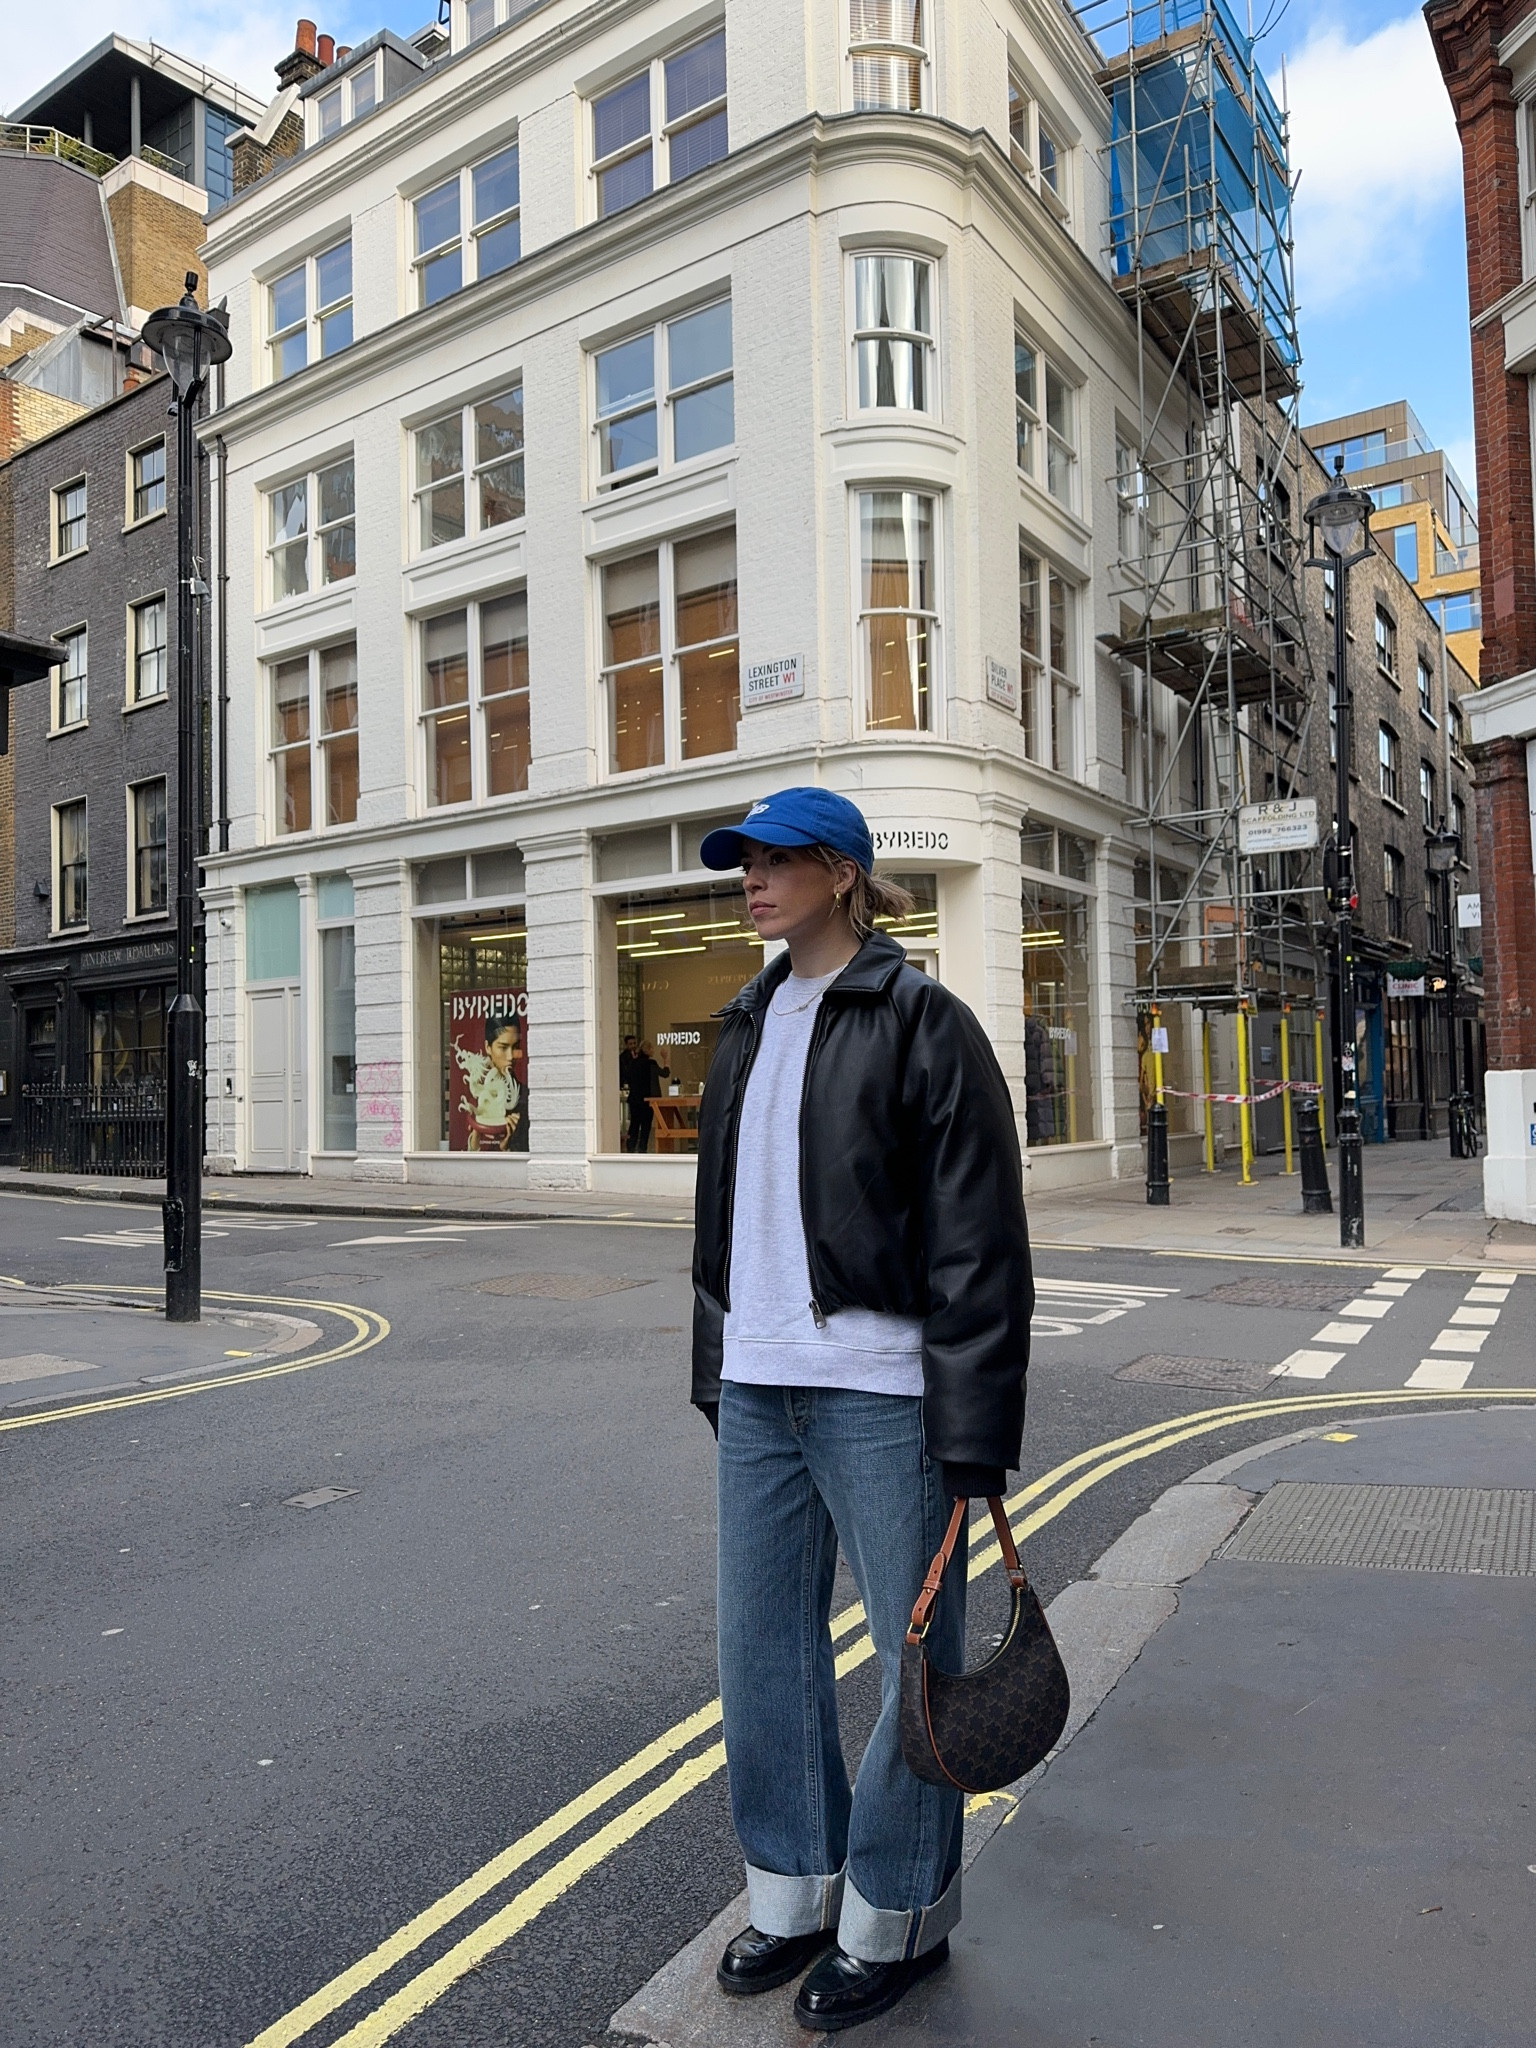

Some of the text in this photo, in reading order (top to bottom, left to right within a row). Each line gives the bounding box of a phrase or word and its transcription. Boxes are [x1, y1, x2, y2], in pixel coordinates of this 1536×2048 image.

[748, 657, 797, 679] LEXINGTON
[991, 661, 1008, 679] SILVER
[748, 671, 796, 692] STREET W1
[991, 674, 1006, 692] PLACE
[1258, 802, 1297, 815] R & J
[1241, 813, 1298, 825] SCAFFOLDING
[871, 831, 949, 850] BYREDO
[1392, 982, 1419, 990] CLINIC
[453, 992, 529, 1020] BYREDO
[656, 1031, 701, 1046] BYREDO
